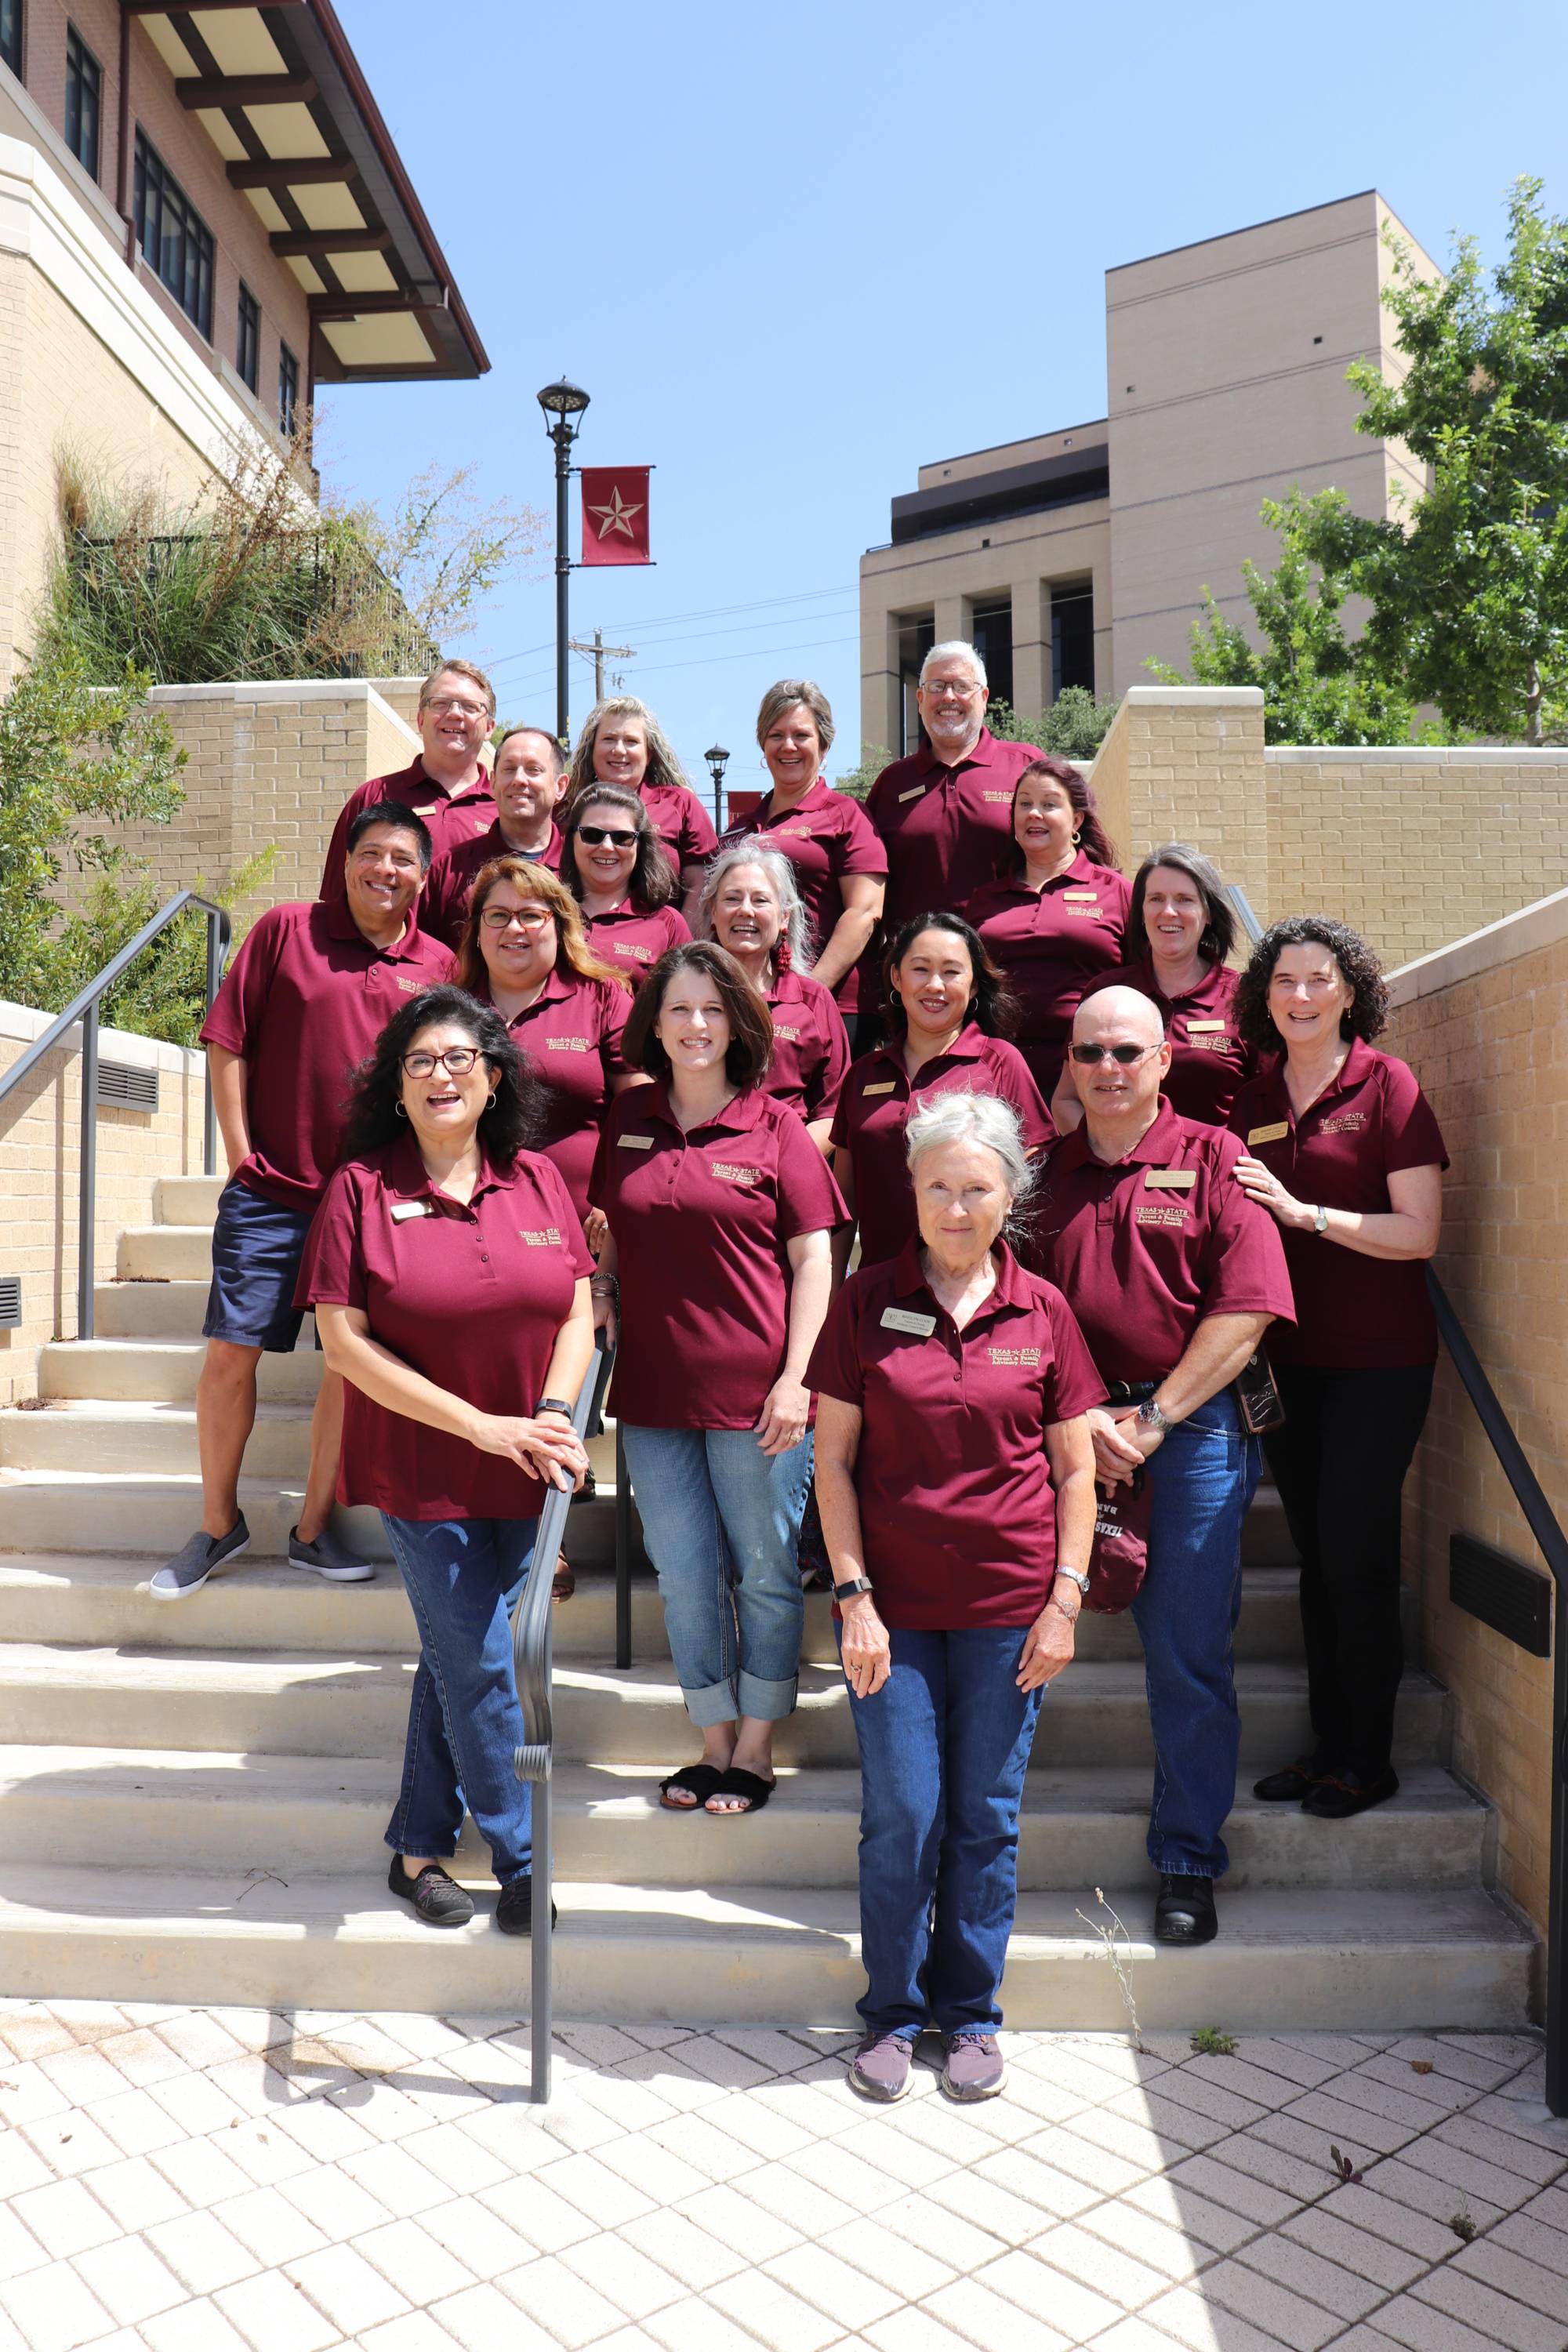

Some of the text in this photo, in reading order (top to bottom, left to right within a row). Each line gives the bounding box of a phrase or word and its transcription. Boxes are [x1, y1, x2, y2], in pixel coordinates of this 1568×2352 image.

[636, 946, 652, 955] STATE
[1214, 1036, 1232, 1045] STATE
[712, 1162, 731, 1171] TEXAS
[1097, 1503, 1118, 1515] BAN
[1095, 1521, 1123, 1537] TEXAS
